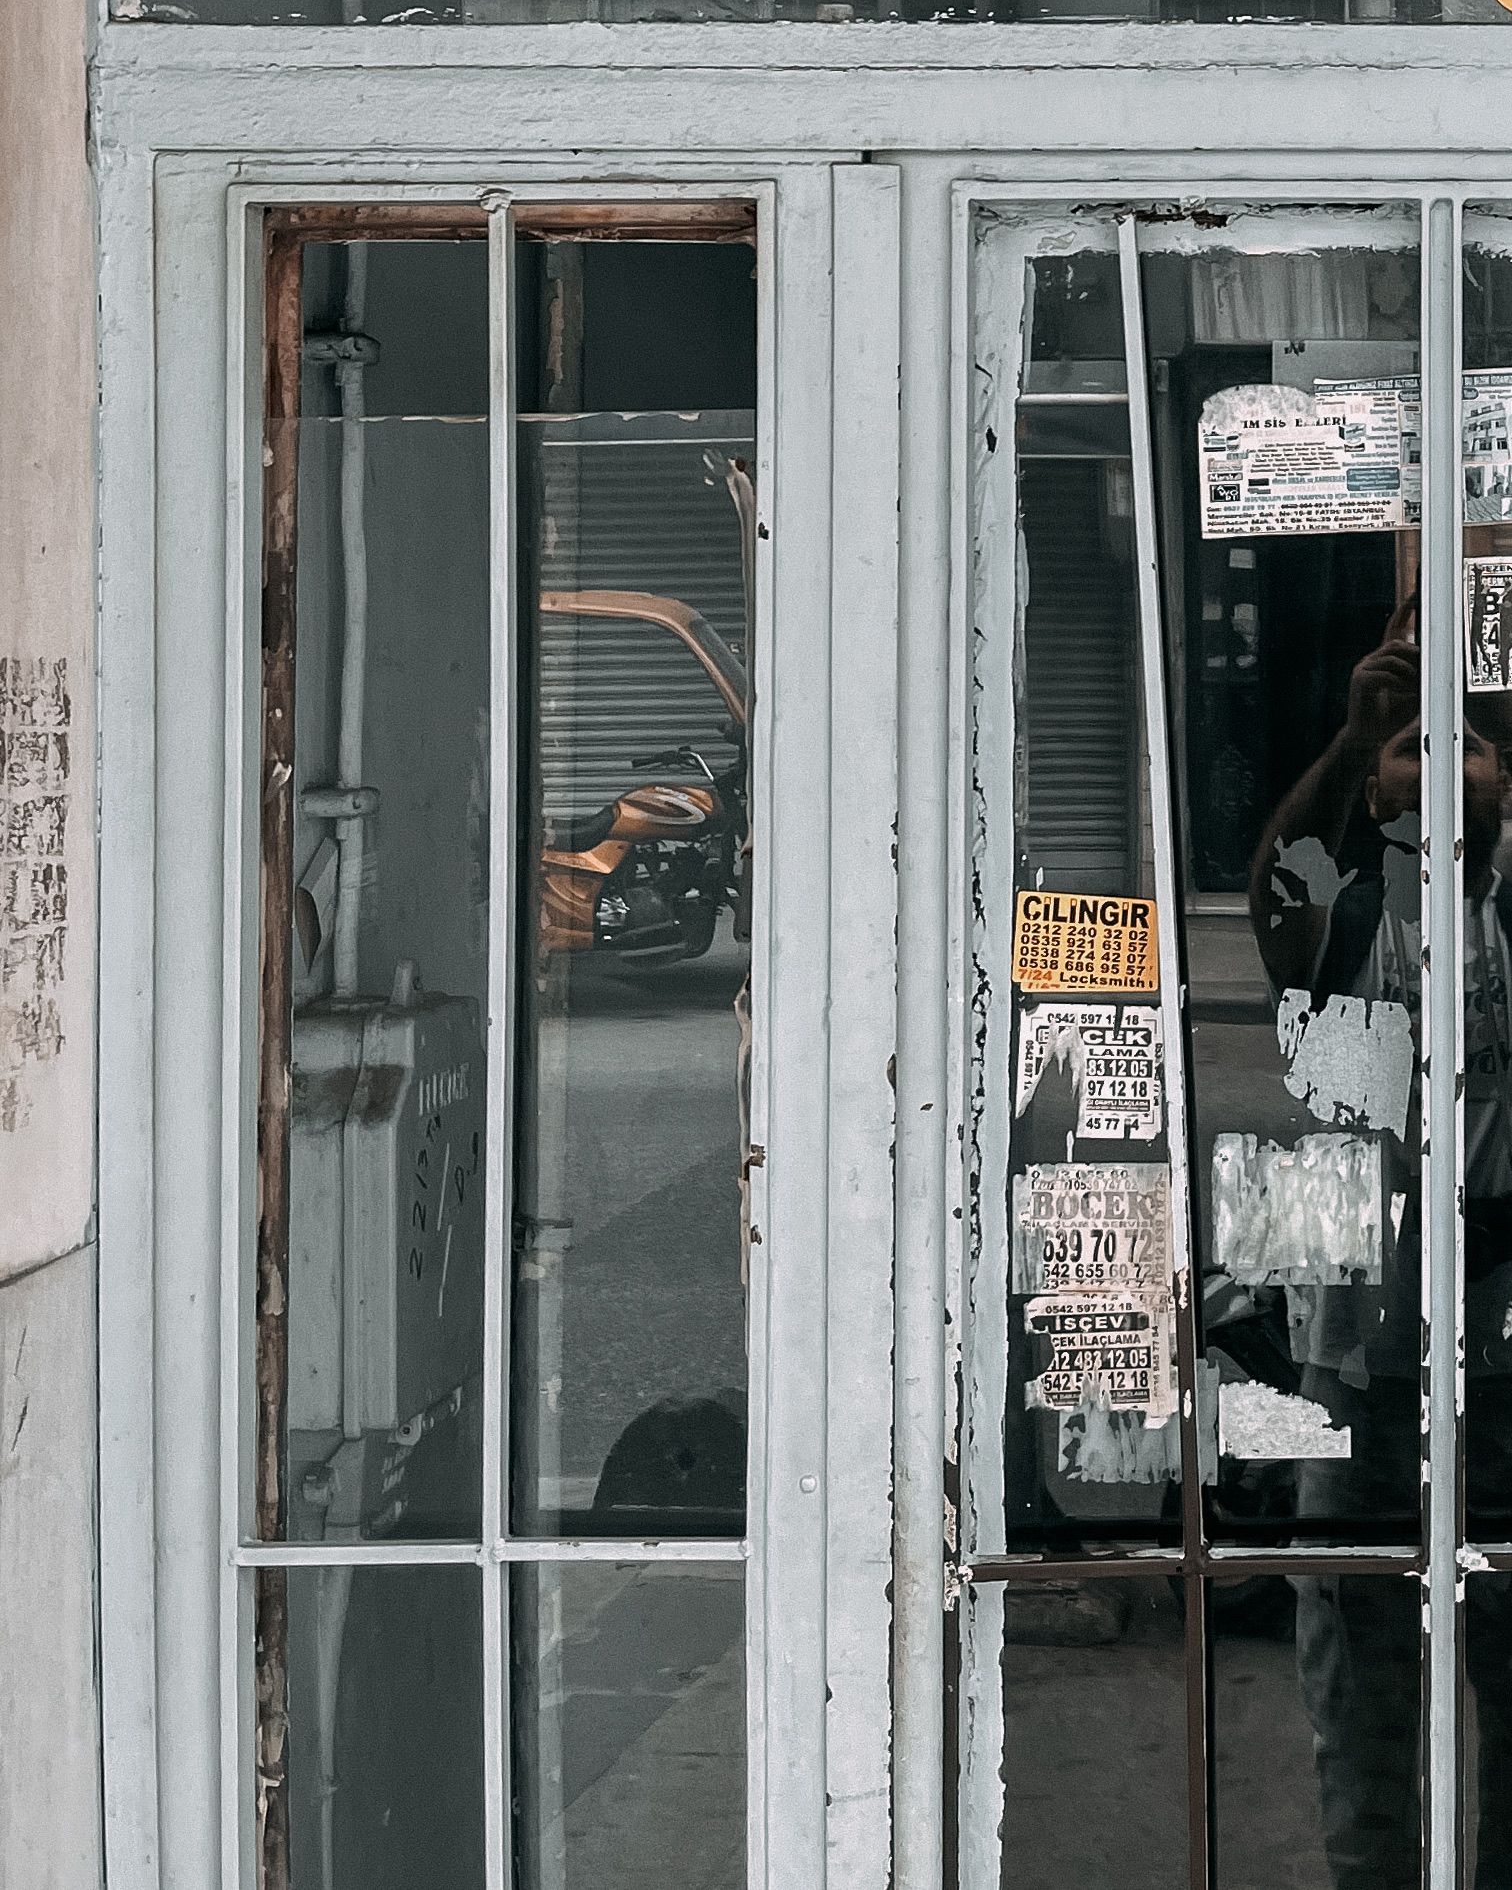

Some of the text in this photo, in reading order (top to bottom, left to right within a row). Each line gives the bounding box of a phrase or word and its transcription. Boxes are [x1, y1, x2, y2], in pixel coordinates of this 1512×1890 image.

[1022, 922, 1148, 941] 0212 240 32 02
[1021, 934, 1148, 953] 0535 921 63 57
[1020, 946, 1147, 965] 0538 274 42 07
[1019, 957, 1146, 977] 0538 686 95 57
[1060, 972, 1145, 988] Locksmith
[1081, 1013, 1103, 1025] 597
[1125, 1014, 1140, 1026] 18
[1109, 1060, 1127, 1077] 12
[1130, 1060, 1148, 1077] 05
[1087, 1080, 1148, 1098] 97 12 18
[1085, 1117, 1101, 1130] 45
[1104, 1118, 1120, 1130] 77
[1090, 1228, 1116, 1263] 70
[1075, 1263, 1104, 1278] 655
[1109, 1263, 1128, 1278] 60
[1045, 1305, 1073, 1314] 0542
[1076, 1303, 1097, 1313] 597
[1102, 1303, 1115, 1312] 12
[1079, 1334, 1142, 1348] İLAÇLAMA
[1107, 1348, 1126, 1368] 12
[1129, 1348, 1149, 1367] 05
[1108, 1371, 1126, 1389] 12
[1131, 1370, 1149, 1389] 18
